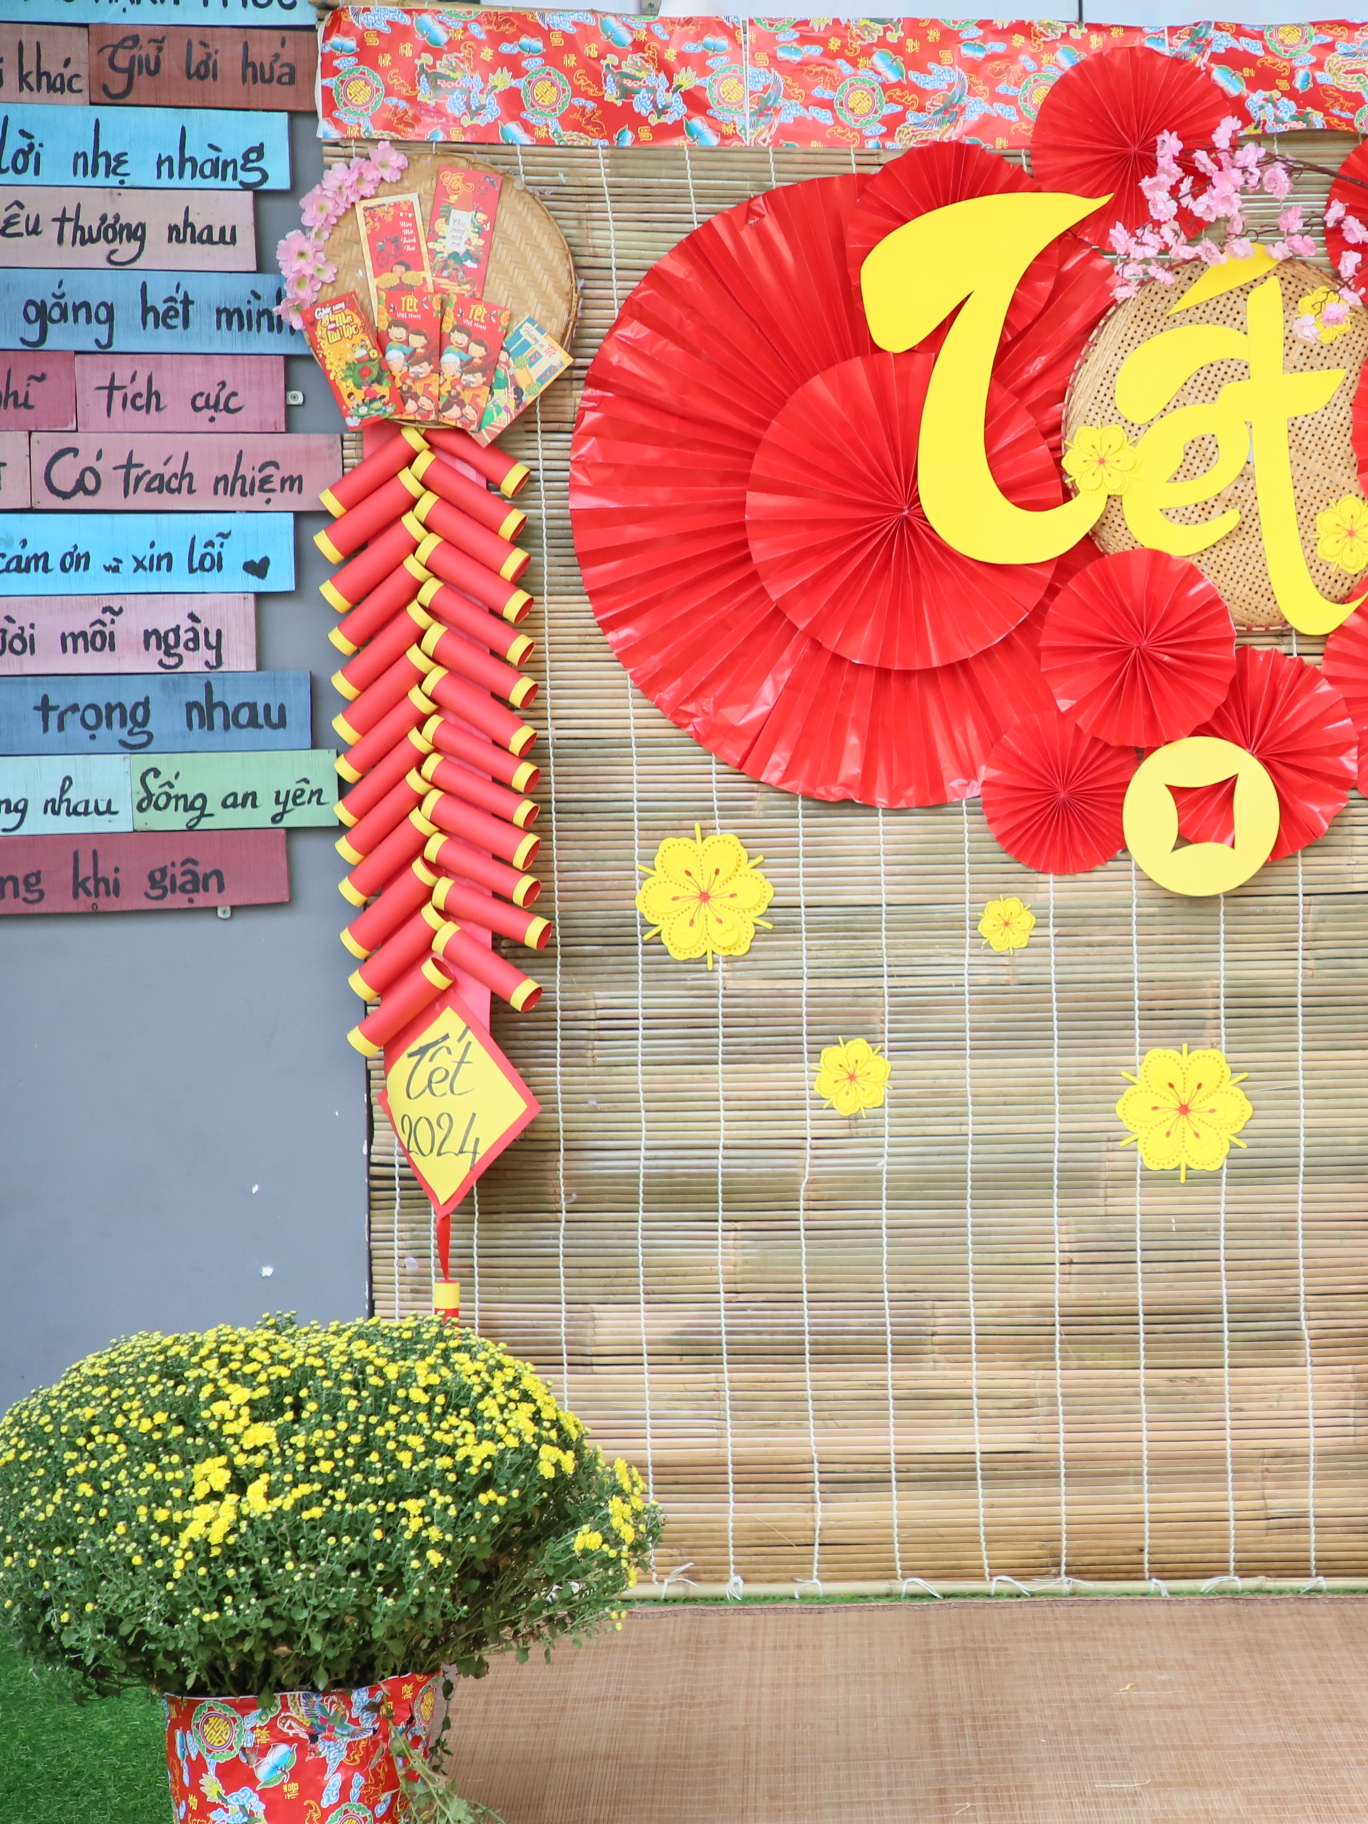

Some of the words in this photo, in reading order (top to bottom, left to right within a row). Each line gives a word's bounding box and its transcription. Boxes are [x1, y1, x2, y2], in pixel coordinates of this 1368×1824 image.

[18, 39, 83, 95] khác
[98, 34, 166, 100] Giữ
[185, 39, 218, 82] lời
[241, 36, 296, 87] hứa
[72, 117, 131, 185] nhẹ
[156, 125, 270, 190] nhàng
[52, 203, 146, 267] thương
[167, 205, 237, 248] nhau
[19, 279, 114, 349] gắng
[141, 281, 194, 332] hết
[95, 370, 167, 418] tích
[190, 381, 245, 423] cực
[44, 447, 102, 500] Có
[112, 450, 197, 499] trách
[213, 449, 304, 505] nhiệm
[59, 544, 91, 573] ơn
[132, 540, 173, 573] xin
[188, 529, 232, 574] lỗi
[60, 605, 124, 655] mỗi
[143, 612, 223, 670] ngày
[34, 693, 155, 751] trọng
[185, 680, 287, 732] nhau
[43, 776, 119, 816] nhau
[136, 767, 214, 831] Sống
[221, 787, 262, 811] an
[270, 777, 329, 824] yên
[72, 849, 121, 900] khi
[145, 857, 226, 904] giận
[406, 1026, 475, 1100] Tết
[401, 1112, 481, 1171] 2024
